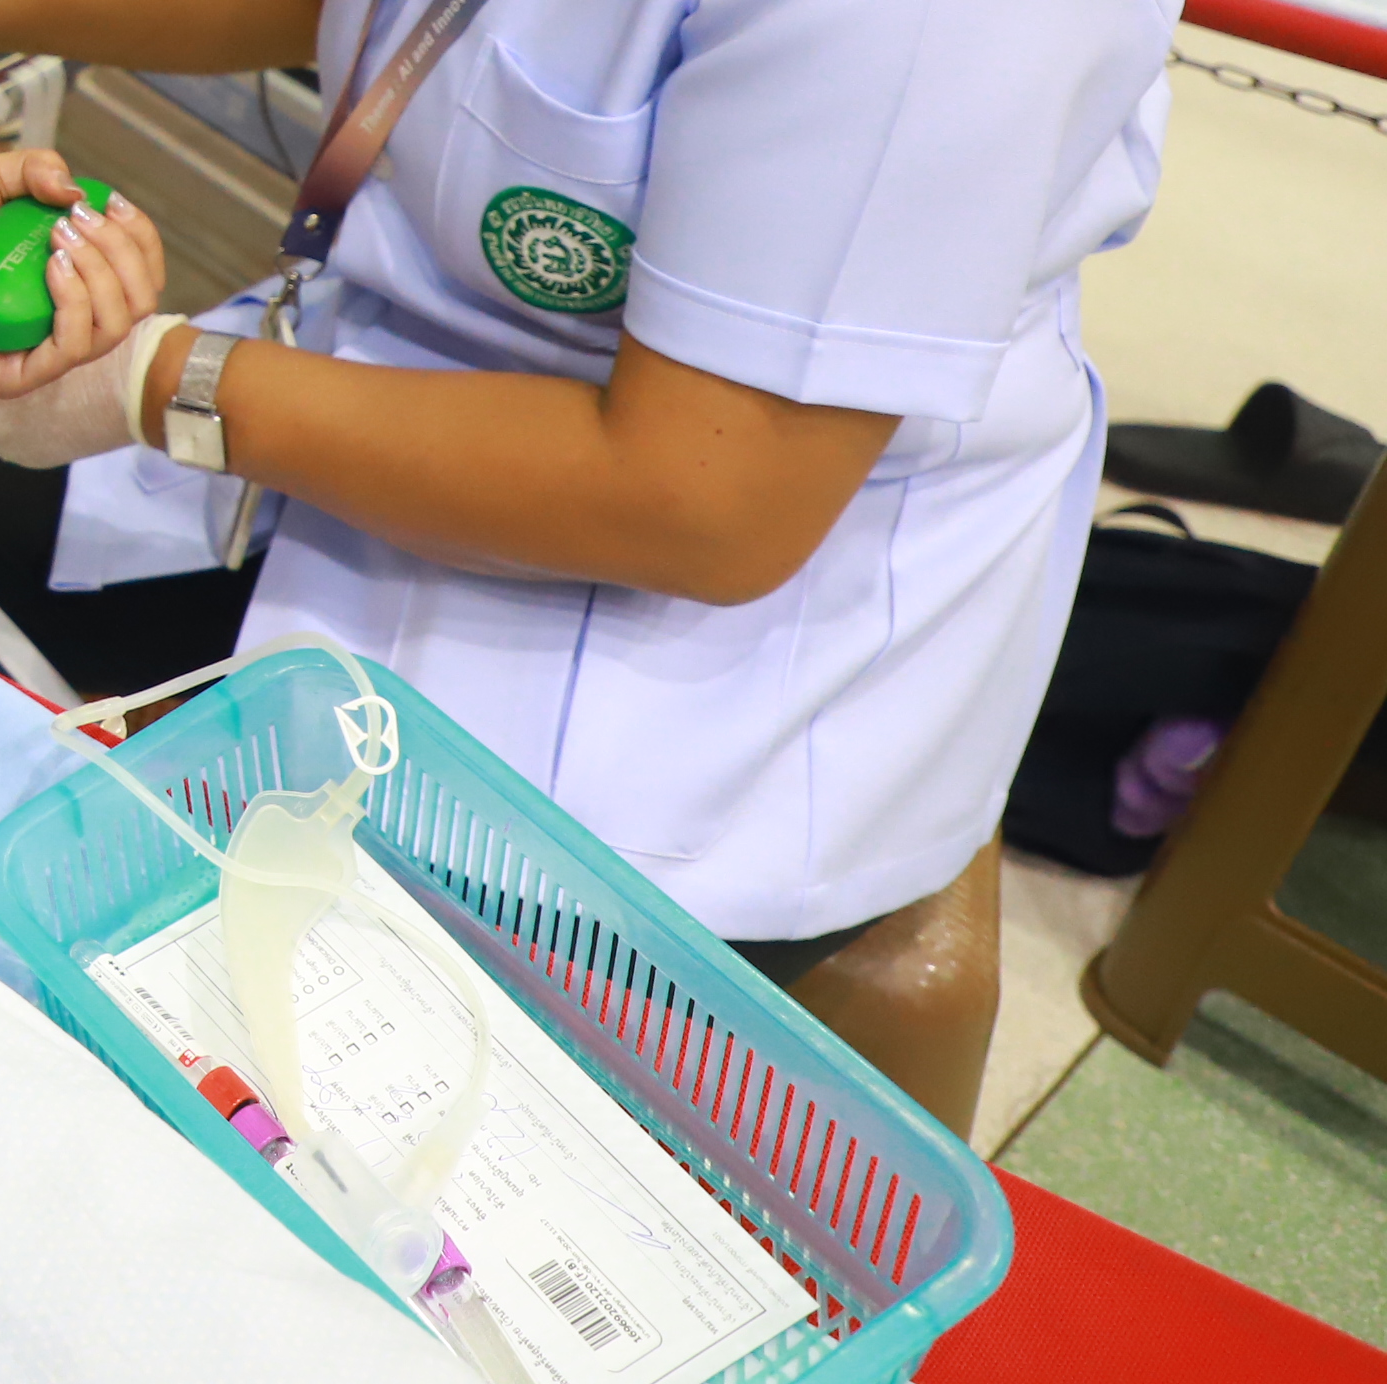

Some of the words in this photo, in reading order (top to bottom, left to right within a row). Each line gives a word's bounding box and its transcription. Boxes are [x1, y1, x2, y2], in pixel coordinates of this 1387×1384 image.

[393, 58, 416, 82] AI
[406, 31, 437, 63] and
[526, 1172, 542, 1188] Hb
[581, 1280, 644, 1344] 16969202120
